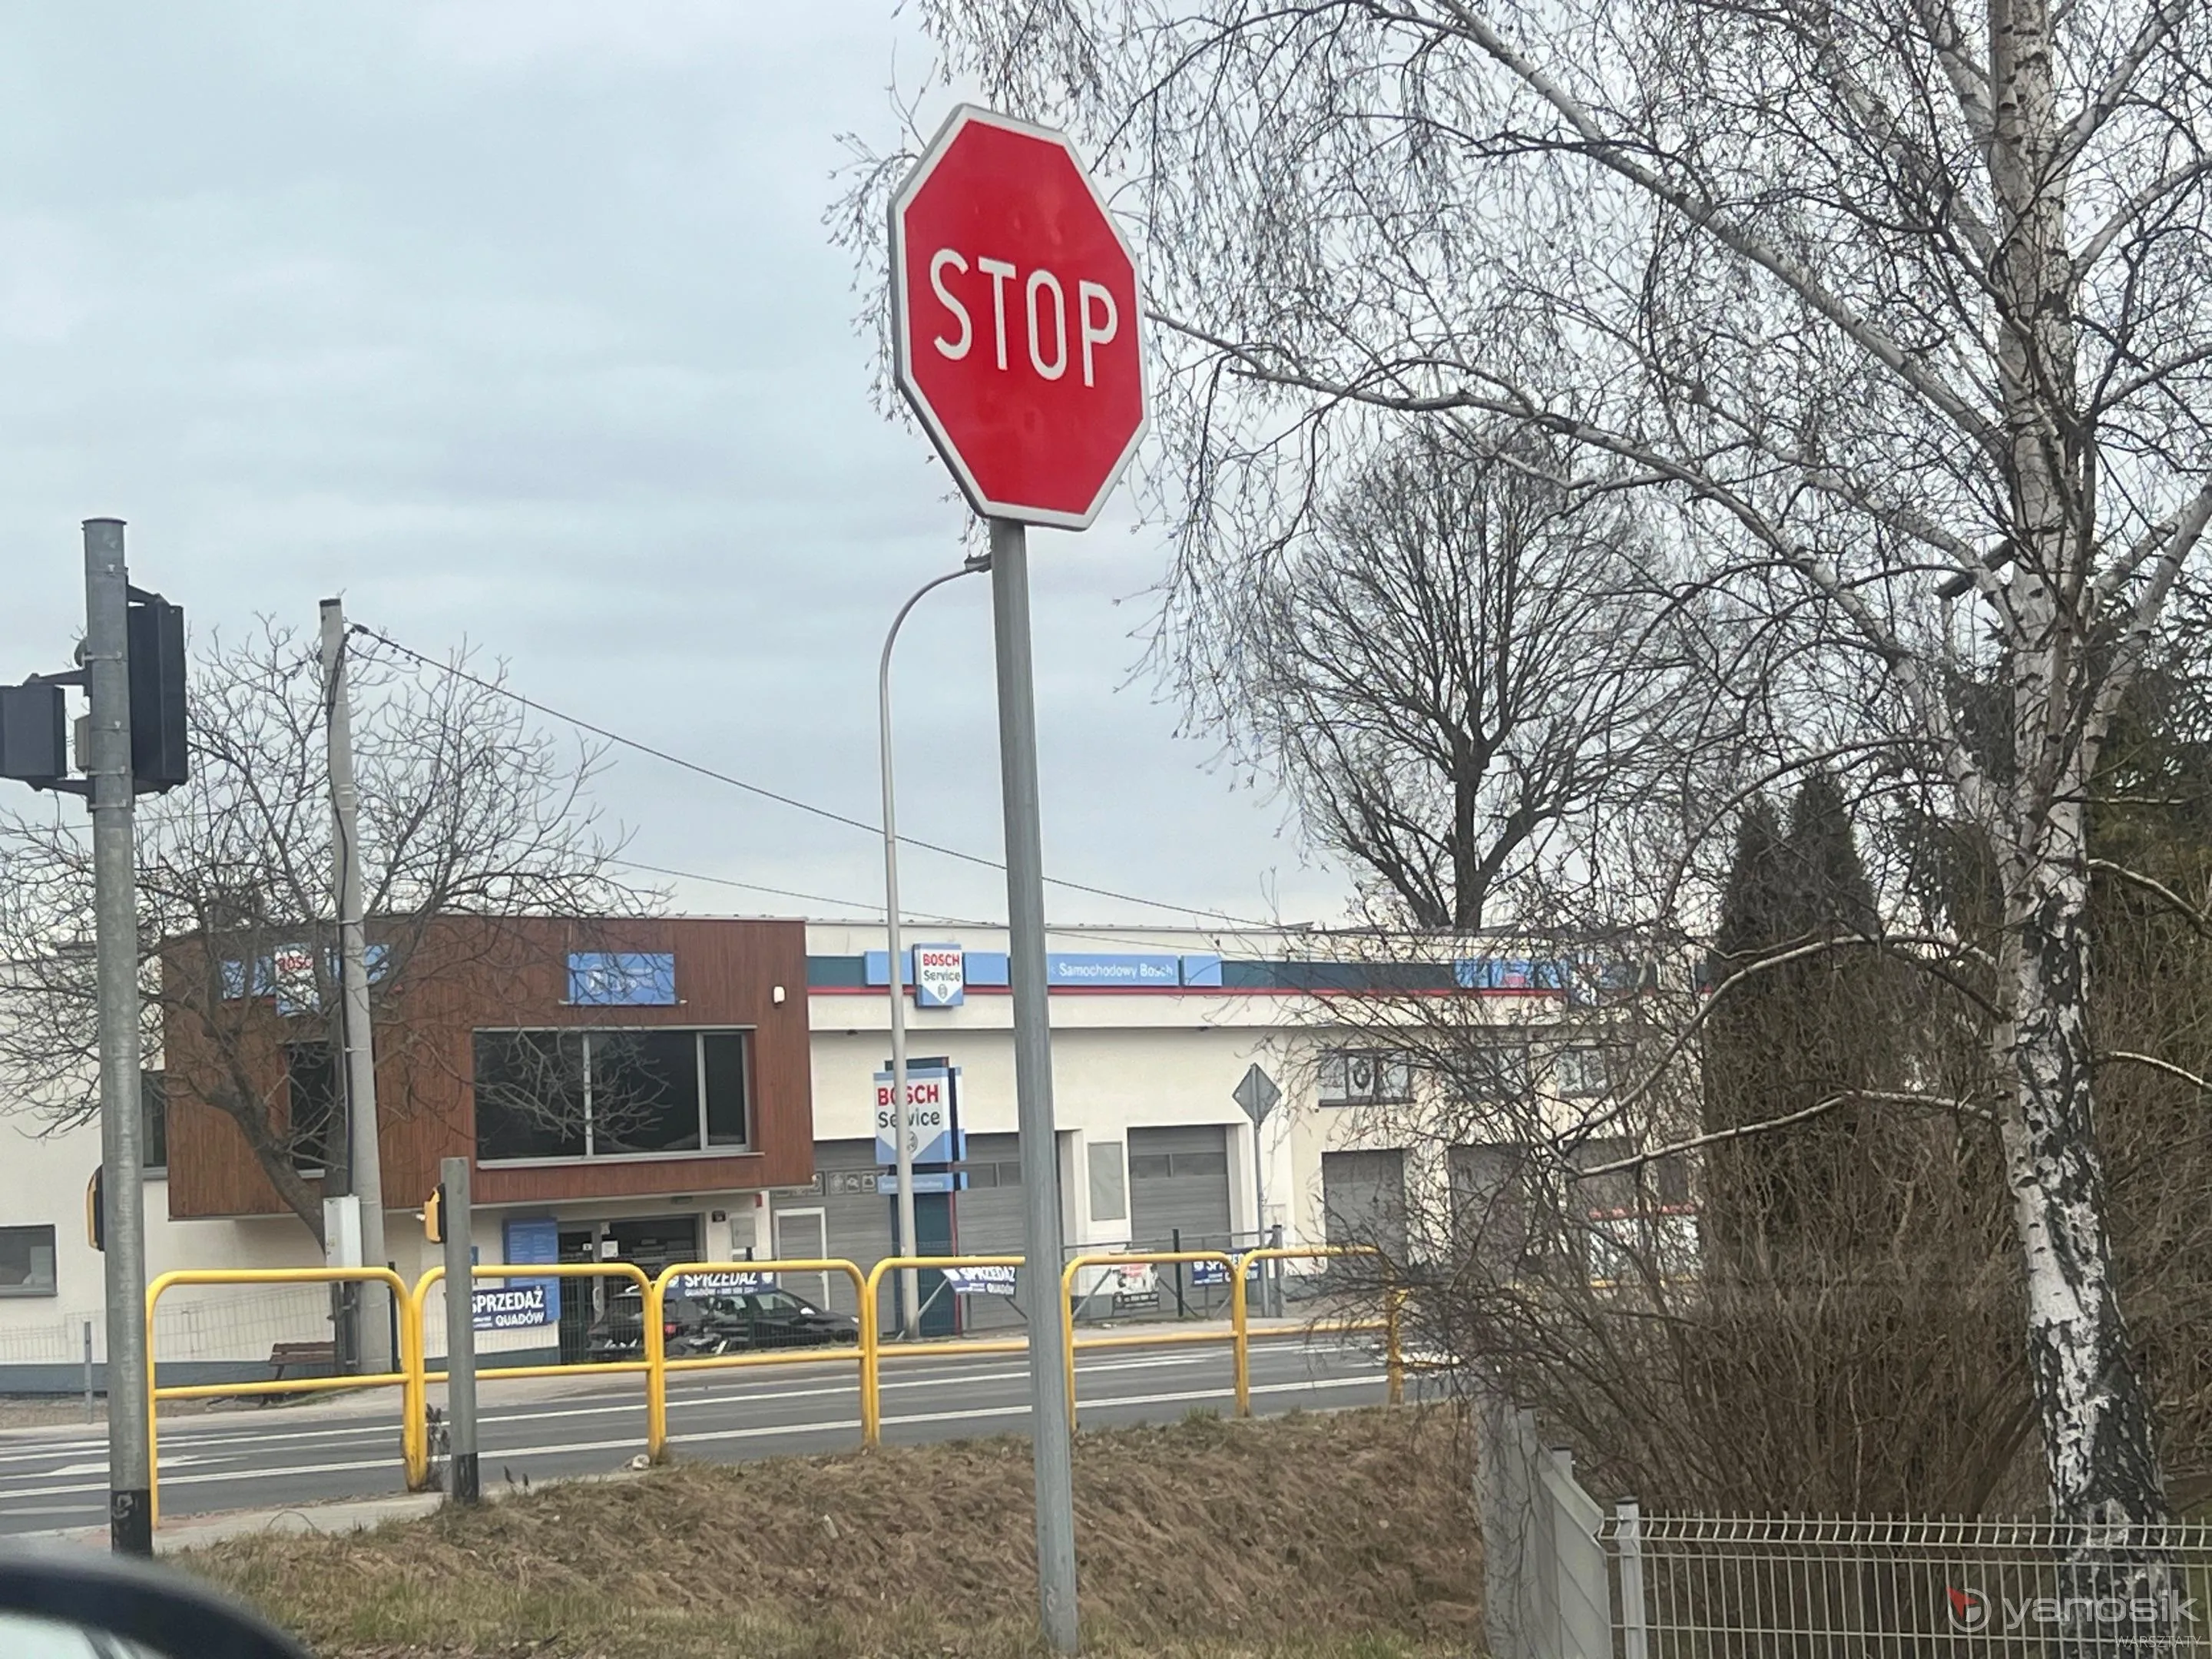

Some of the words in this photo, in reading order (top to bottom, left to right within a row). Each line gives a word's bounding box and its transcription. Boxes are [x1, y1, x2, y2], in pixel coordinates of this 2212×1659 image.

[929, 247, 1119, 388] STOP
[922, 953, 960, 966] BOSCH
[923, 969, 961, 982] Service
[1058, 962, 1137, 979] Samochodowy
[1140, 962, 1173, 978] Bosch
[878, 1107, 941, 1129] Sevice
[495, 1310, 545, 1326] QUADÓW
